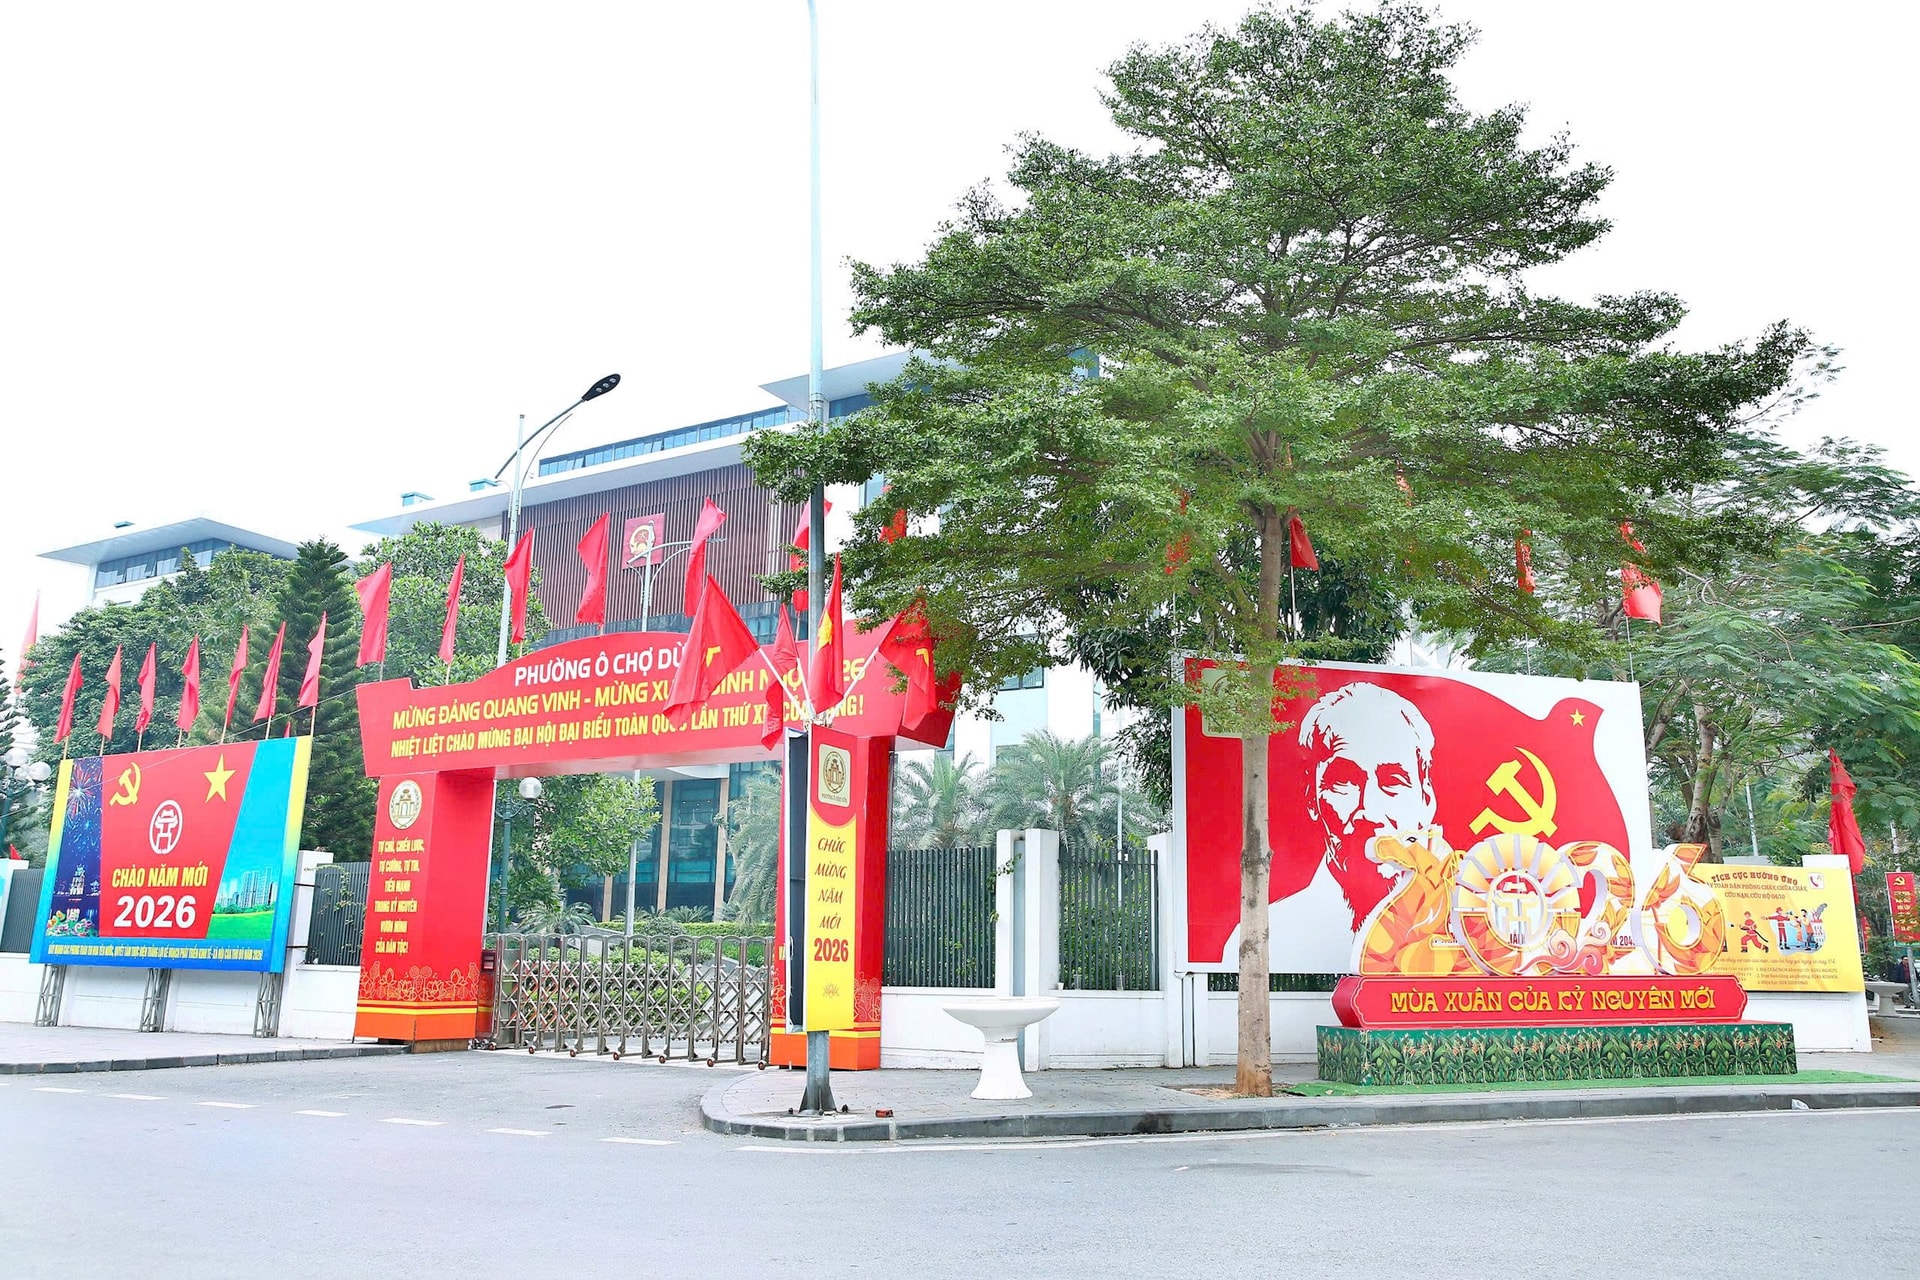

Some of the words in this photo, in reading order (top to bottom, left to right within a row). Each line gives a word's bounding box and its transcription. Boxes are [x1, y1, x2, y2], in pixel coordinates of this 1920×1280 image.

[514, 657, 591, 686] PHƯỜNG
[595, 651, 609, 676] Ô
[613, 646, 653, 676] CHỢ
[658, 641, 688, 670] DỪ
[393, 705, 435, 730] MỪNG
[438, 699, 480, 724] ĐẢNG
[483, 695, 538, 722] QUANG
[542, 689, 581, 713] VINH
[594, 680, 649, 707] MỪNG
[391, 735, 421, 760] NHIỆT
[422, 733, 444, 757] LIỆT
[446, 730, 474, 753] CHÀO
[477, 727, 511, 749] MỪNG
[513, 726, 533, 749] ĐẠI
[537, 721, 556, 747] HỘI
[559, 722, 580, 745] ĐẠI
[583, 711, 611, 739] BIỂU
[615, 712, 649, 737] TOÀN
[691, 702, 718, 730] LẦN
[722, 701, 751, 727] THỨ
[818, 836, 846, 853] CHÚC
[112, 864, 146, 888] CHÀO
[147, 863, 179, 887] NĂM
[181, 860, 209, 887] MỚI
[814, 861, 847, 880] MỪNG
[1711, 873, 1731, 883] TÍCH
[818, 888, 843, 904] NĂM
[113, 895, 196, 929] 2026
[819, 912, 841, 929] MỚI
[814, 937, 849, 962] 2026
[1390, 987, 1439, 1013] MÙA
[1443, 986, 1503, 1013] XUÂN
[1508, 984, 1553, 1012] CỦA
[1557, 983, 1585, 1011] KỶ
[1591, 985, 1675, 1010] NGUYÊN
[1680, 985, 1716, 1010] MỚI
